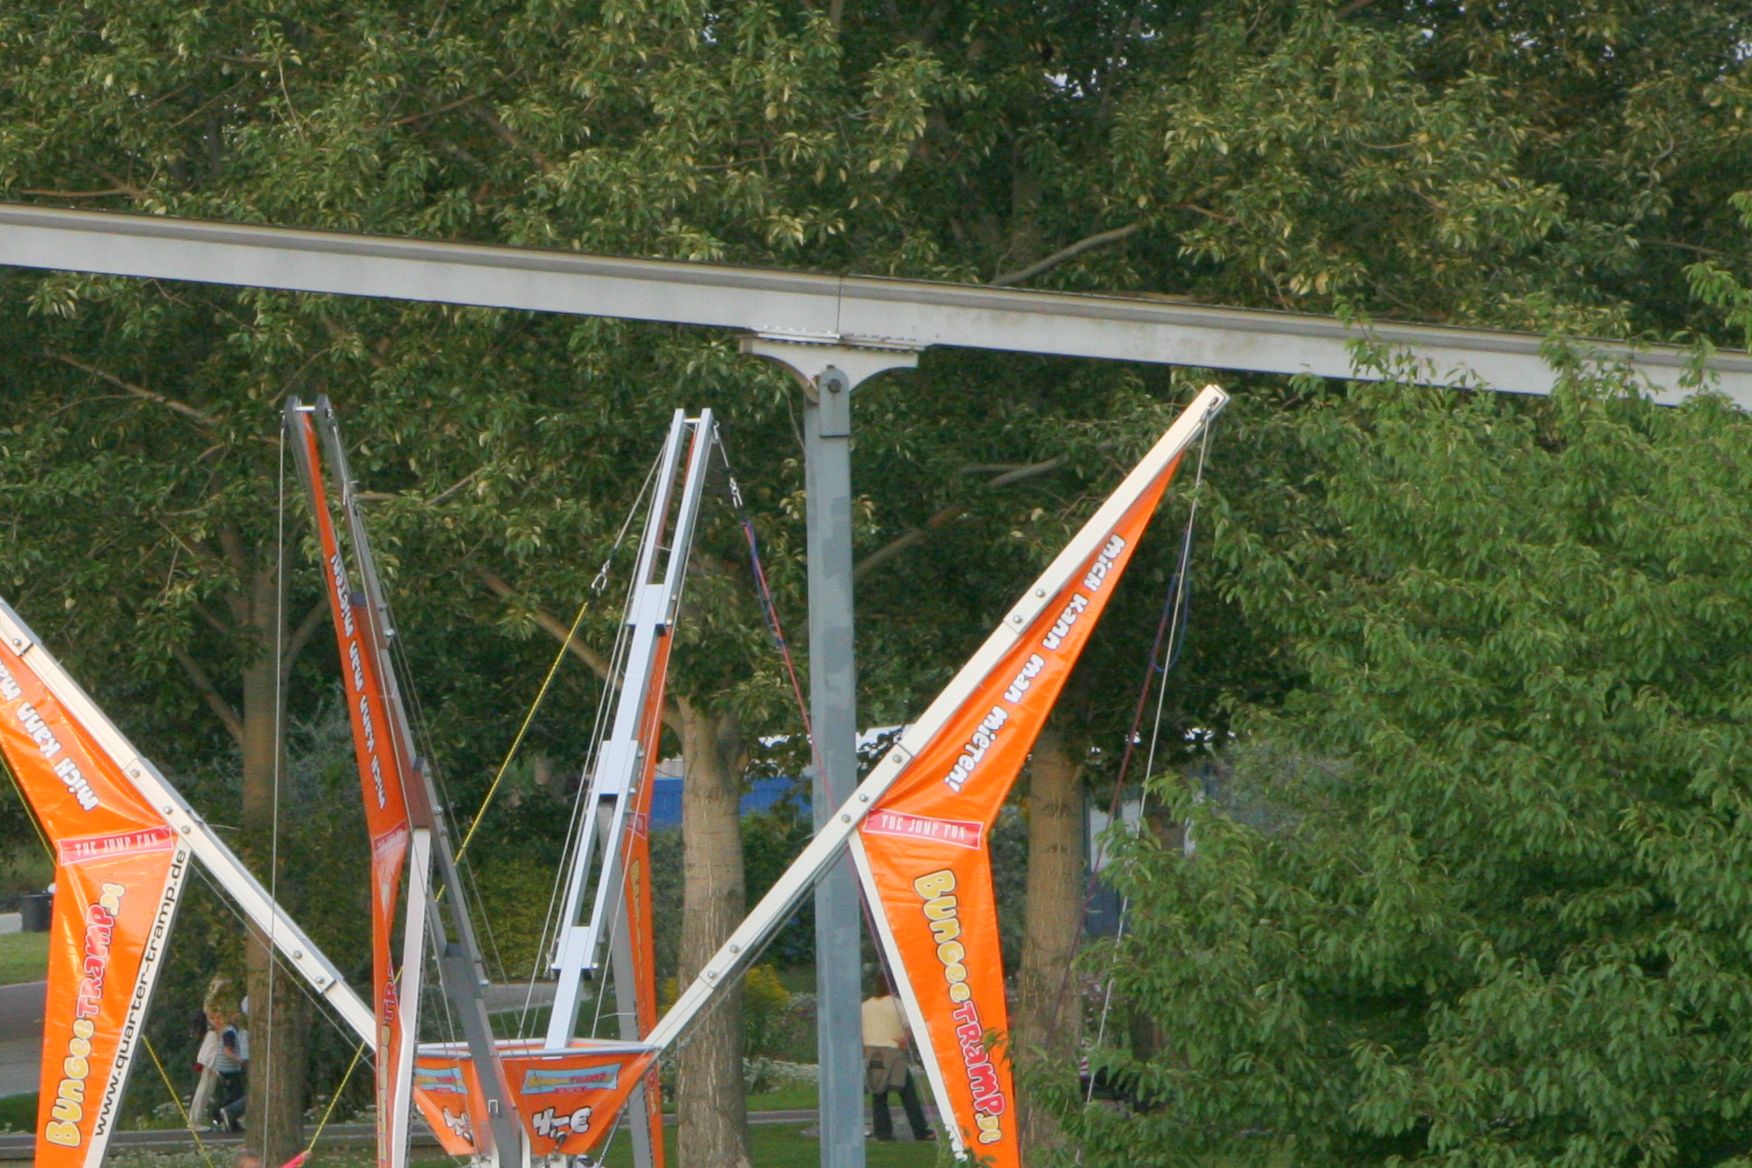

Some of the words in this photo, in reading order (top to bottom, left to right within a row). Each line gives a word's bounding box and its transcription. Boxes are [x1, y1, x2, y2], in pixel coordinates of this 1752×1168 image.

[1003, 653, 1046, 704] man
[103, 837, 131, 852] JUMP
[908, 819, 938, 837] JUMP
[94, 848, 186, 1137] www.quarter-tramp.de
